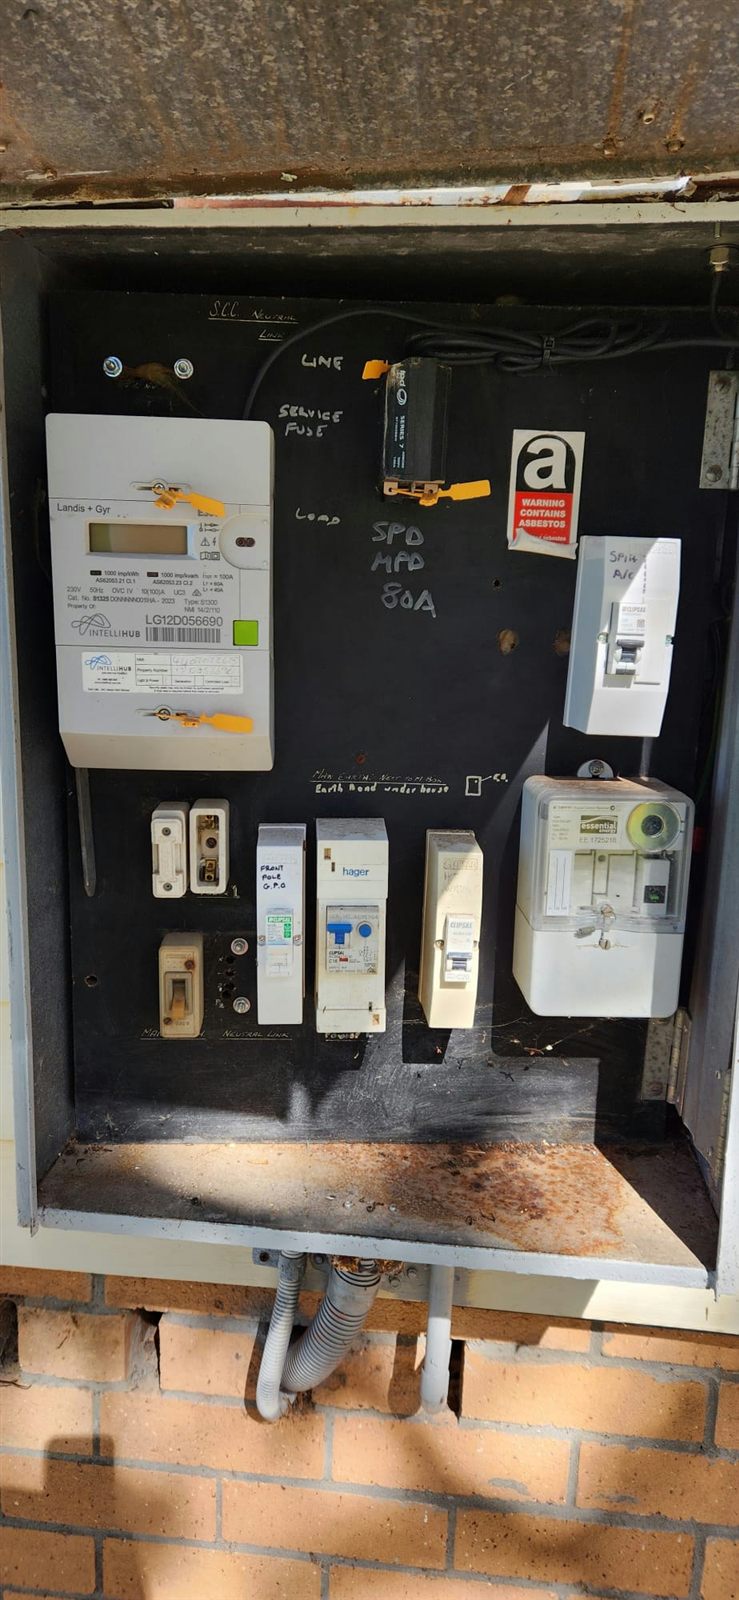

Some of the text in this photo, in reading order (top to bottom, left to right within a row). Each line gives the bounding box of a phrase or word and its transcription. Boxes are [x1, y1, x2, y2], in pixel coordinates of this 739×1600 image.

[302, 354, 343, 370] LINE
[278, 404, 343, 423] SERVICE
[285, 422, 328, 436] FUSE
[524, 438, 566, 489] a
[522, 498, 565, 507] WARNING
[57, 504, 85, 512] Landis
[96, 505, 111, 515] Gyr
[520, 508, 566, 518] CONTAINS
[296, 508, 340, 526] LOAD
[519, 520, 566, 528] ASBESTOS
[372, 521, 424, 546] SPD
[381, 582, 436, 618] 80A
[146, 614, 223, 627] LG12D056690
[89, 629, 140, 638] INTELLIHUB
[315, 782, 449, 794] Earth Bond under house
[581, 821, 616, 830] essential
[343, 866, 369, 877] hager
